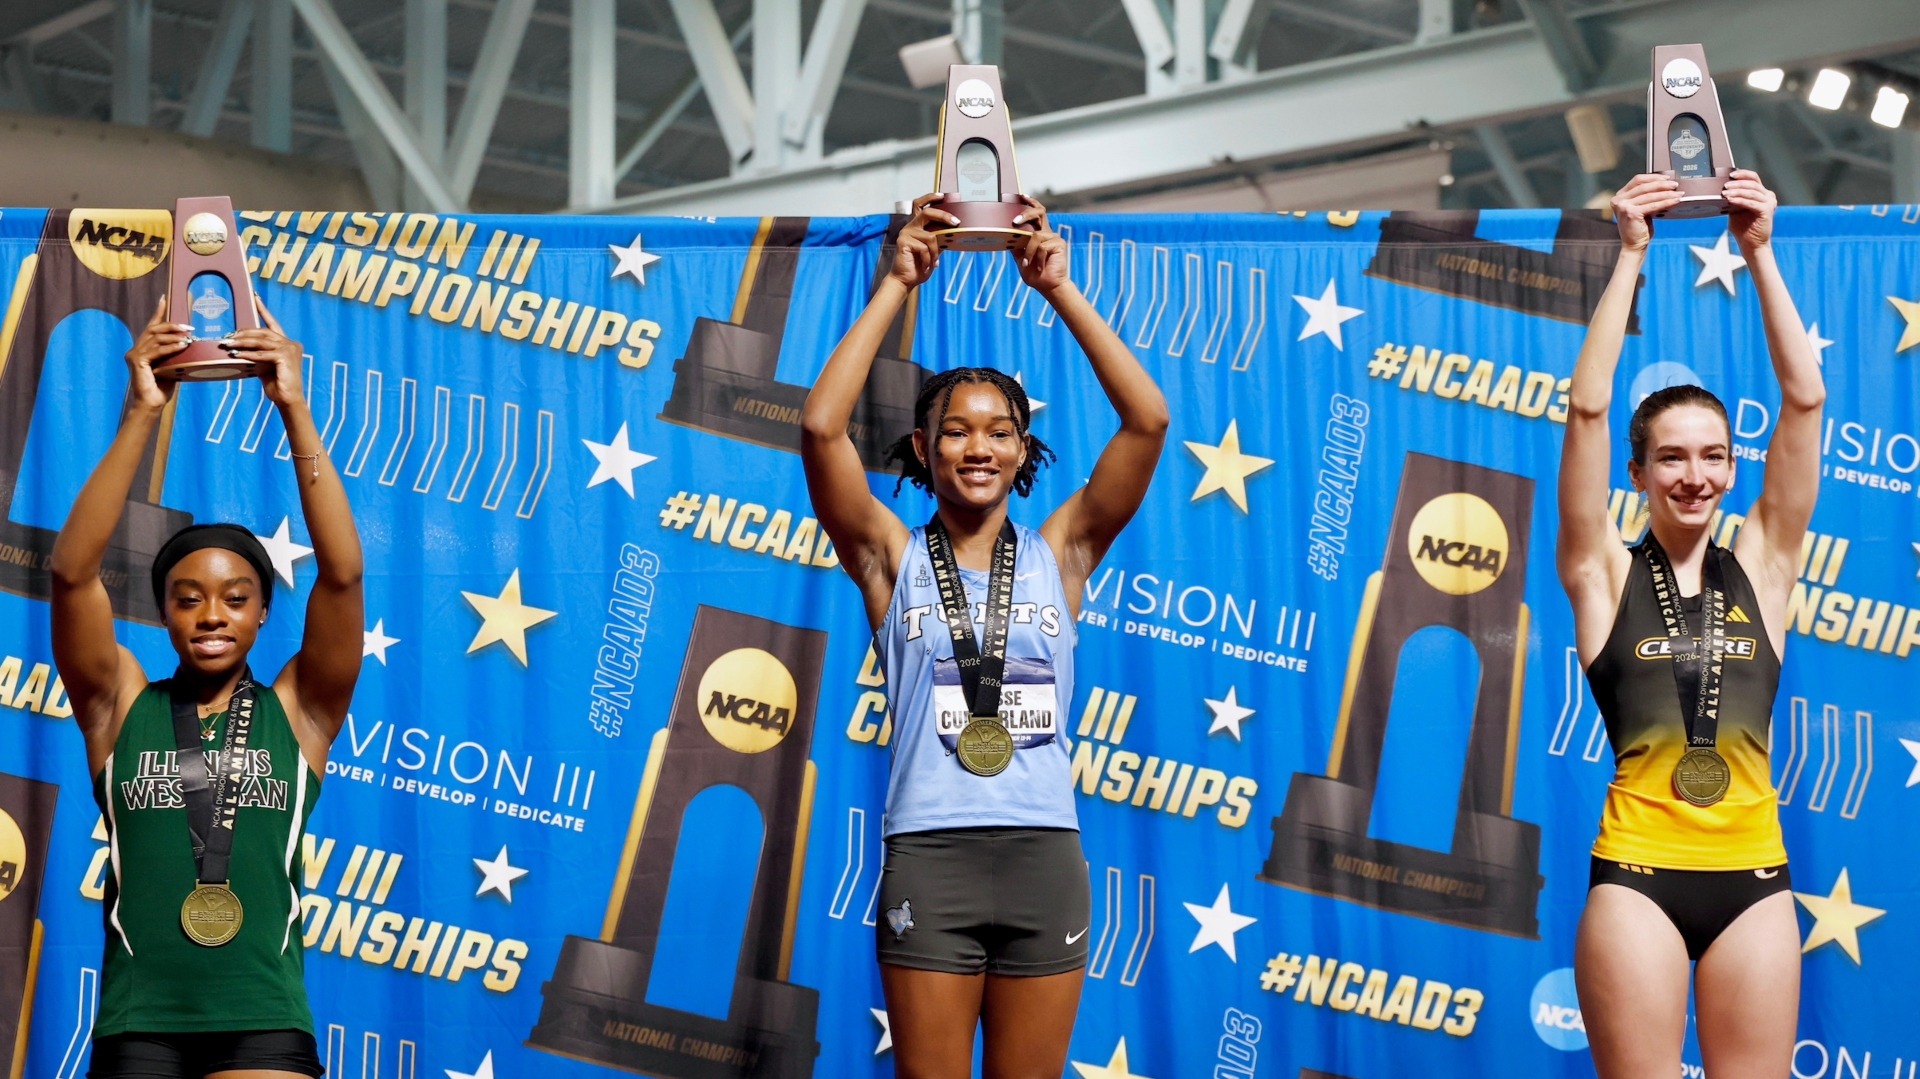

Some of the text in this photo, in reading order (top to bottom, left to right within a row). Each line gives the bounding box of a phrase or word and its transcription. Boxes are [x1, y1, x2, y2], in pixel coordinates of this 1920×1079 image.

[958, 96, 995, 109] NCAA
[1666, 76, 1702, 89] NCAA
[75, 218, 166, 264] NCAA
[187, 230, 226, 245] NCAA
[477, 229, 541, 286] III
[1435, 252, 1584, 298] NATIONAL CHAMPION
[240, 225, 662, 369] CHAMPIONSHIPS
[1367, 341, 1572, 424] #NCAAD3
[1307, 393, 1370, 581] #NCAAD3
[1834, 466, 1912, 494] DEVELOP
[659, 490, 841, 569] #NCAAD
[0, 543, 39, 569] ONAL
[993, 556, 1001, 575] TRACK
[1415, 534, 1501, 578] NCAA
[928, 533, 965, 641] ALL-AMERICAN
[991, 576, 999, 601] INDOOR
[993, 542, 1014, 659] ALL-AMERICAN
[1642, 542, 1680, 637] LL-AMERICAN
[963, 620, 973, 639] FIELD
[986, 607, 995, 637] DIVISION
[1085, 567, 1317, 651] VISION III
[1671, 595, 1682, 613] TRACK
[1678, 619, 1689, 636] FIELD
[1704, 608, 1712, 627] TRACK
[588, 542, 660, 738] #NCAAD3
[984, 637, 992, 658] NCAA
[1124, 621, 1206, 649] DEVELOP
[1222, 641, 1308, 673] DEDICATE
[1640, 640, 1752, 656] CERE
[1675, 651, 1697, 663] 2026
[1703, 628, 1711, 656] INDOOR
[1706, 590, 1725, 721] ALL-AMERICAN
[959, 657, 981, 668] 2026
[980, 676, 1002, 688] 2026
[1700, 664, 1710, 697] DIVISION
[230, 697, 240, 712] FIELD
[705, 690, 790, 737] NCAA
[1076, 686, 1138, 746] III
[1697, 696, 1707, 717] NCAA
[226, 718, 236, 736] TRACK
[222, 737, 233, 765] INDOOR
[222, 698, 253, 831] ALL-AMERICAN
[347, 712, 596, 811] VISION III
[215, 772, 227, 805] DIVISION
[392, 776, 476, 806] DEVELOP
[494, 799, 585, 833] DEDICATE
[212, 806, 222, 828] NCAA
[336, 844, 404, 905] III
[1332, 853, 1487, 901] NATIONAL CHAMPION
[301, 893, 529, 993] ONSHIPS
[1260, 951, 1485, 1038] #NCAAD3
[1535, 1002, 1586, 1034] NCA
[603, 1019, 760, 1067] NATIONAL CHAMPION
